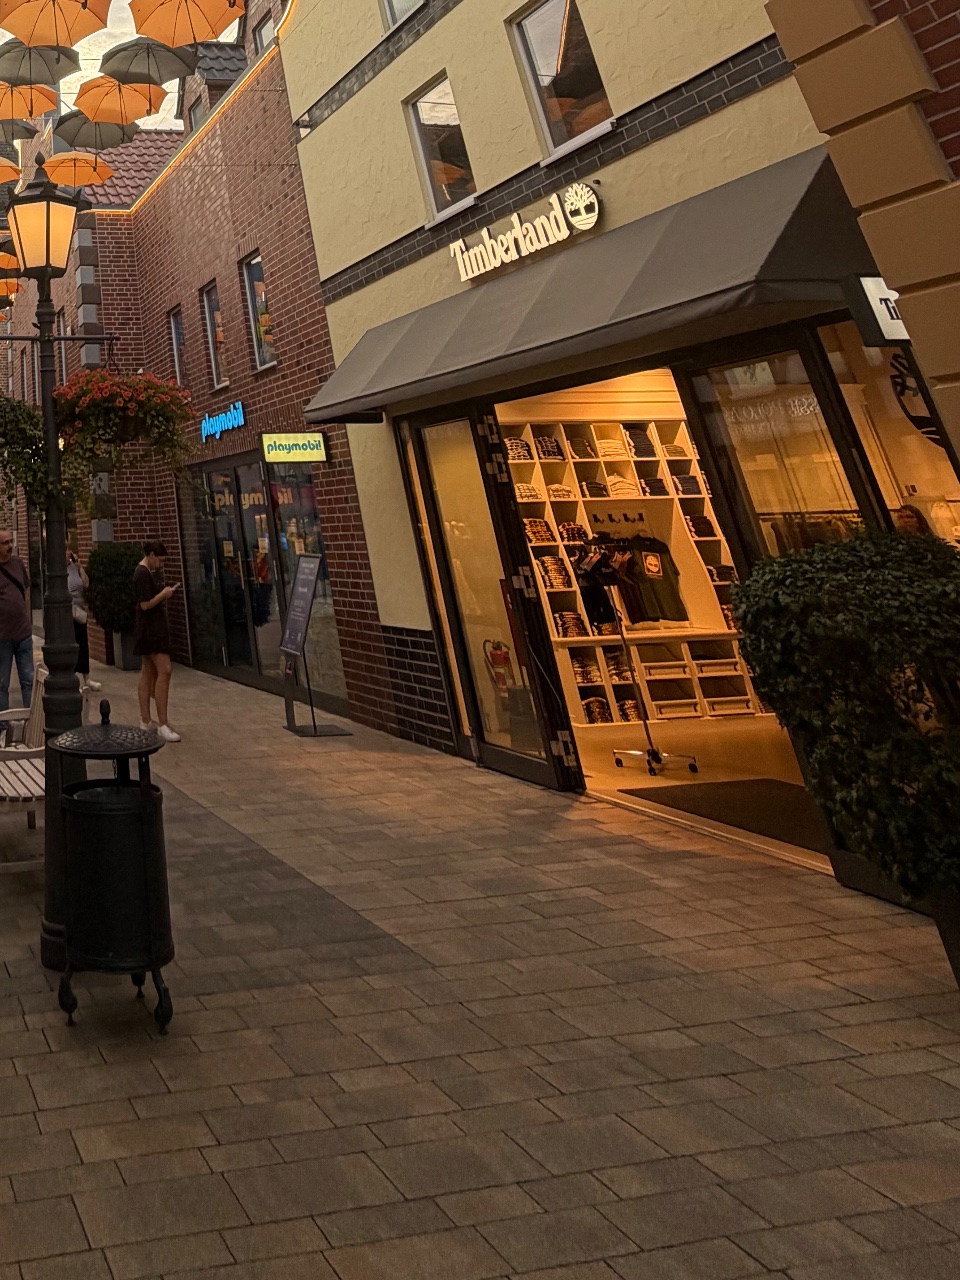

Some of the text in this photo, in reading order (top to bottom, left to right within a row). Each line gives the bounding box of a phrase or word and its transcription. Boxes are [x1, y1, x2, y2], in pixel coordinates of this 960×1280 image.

[449, 193, 571, 282] Timberland
[201, 401, 244, 443] playmobil
[267, 440, 322, 454] playmobil
